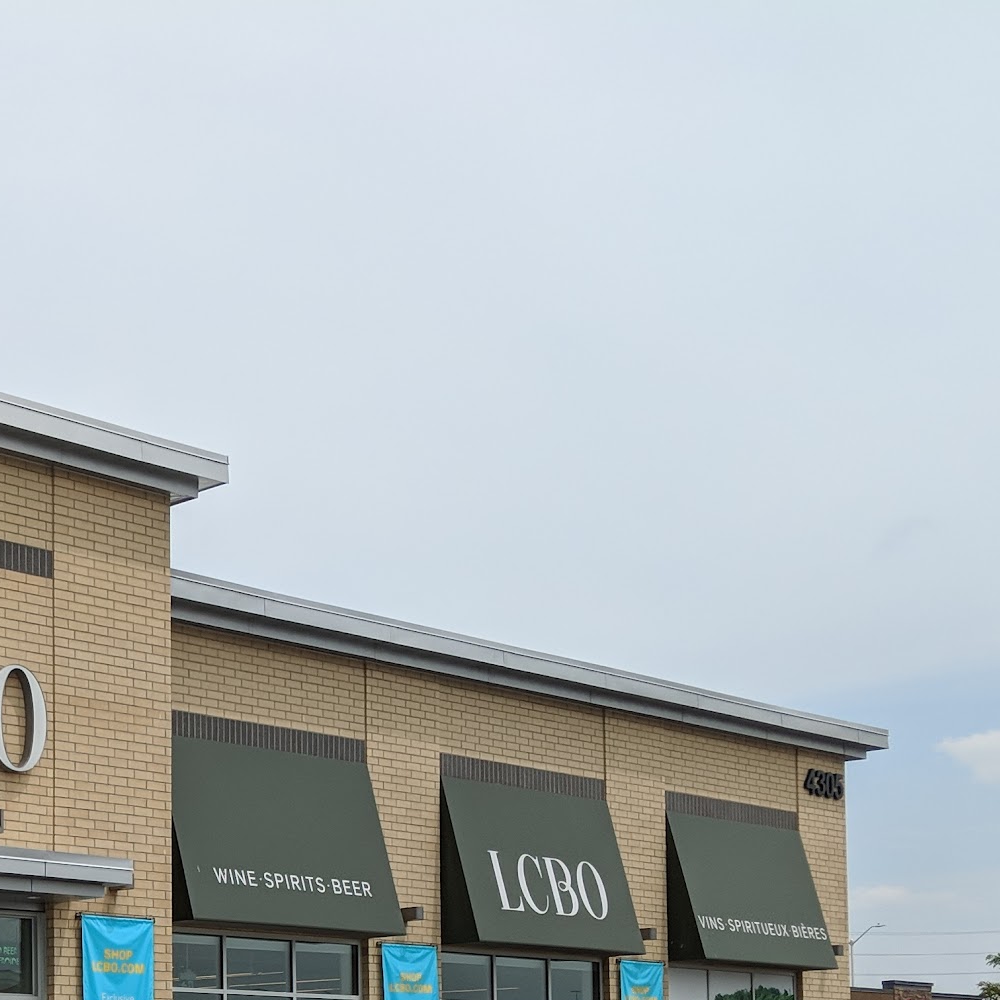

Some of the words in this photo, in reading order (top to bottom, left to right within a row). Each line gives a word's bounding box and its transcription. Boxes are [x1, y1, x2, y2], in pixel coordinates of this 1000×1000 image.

[803, 768, 844, 800] 4305
[487, 850, 608, 920] LCBO
[104, 948, 133, 961] SHOP
[92, 961, 144, 974] LCBO.COM
